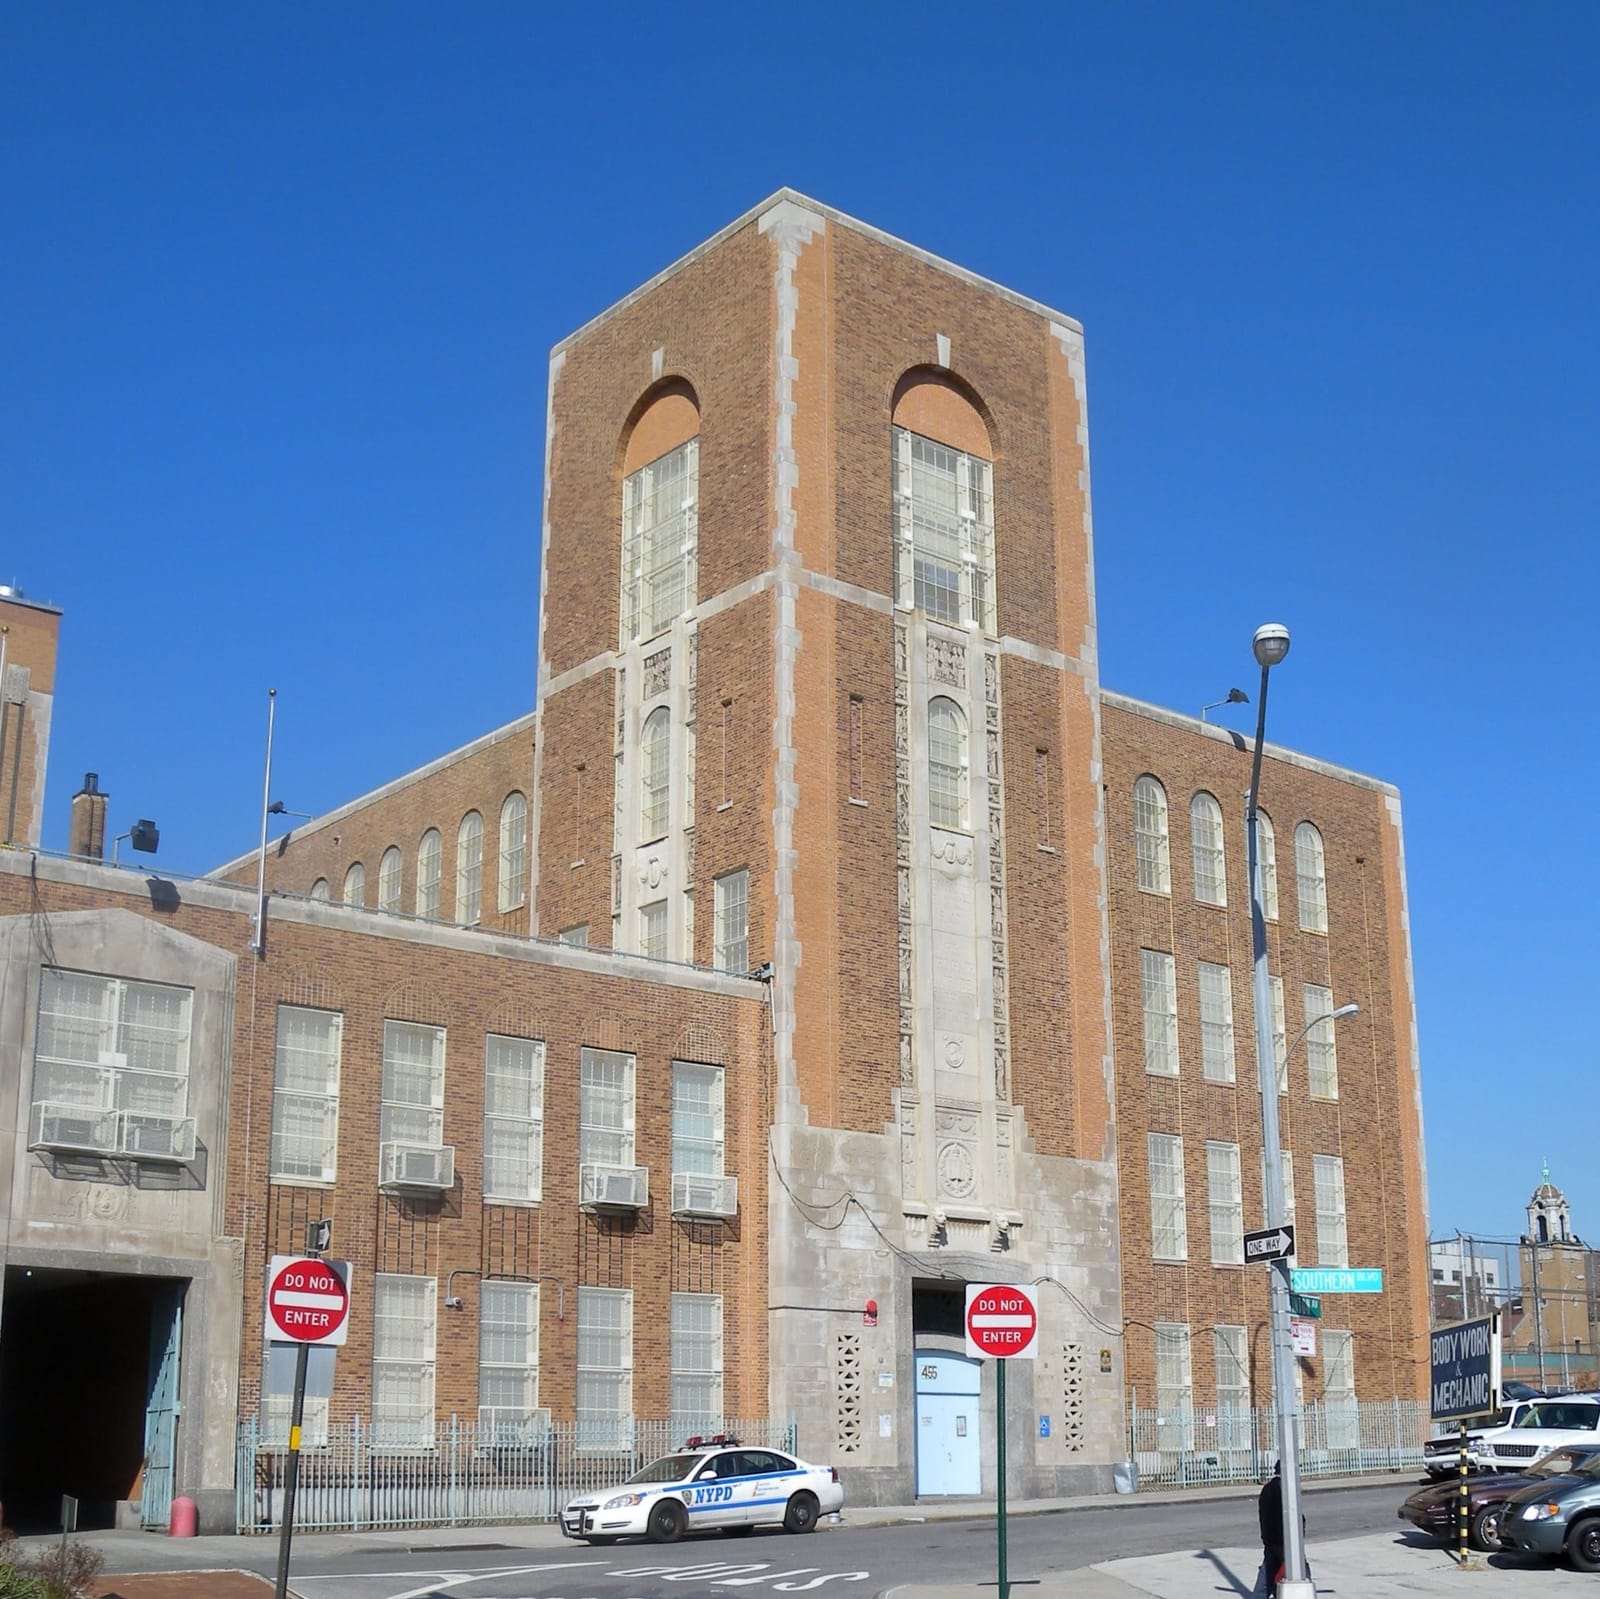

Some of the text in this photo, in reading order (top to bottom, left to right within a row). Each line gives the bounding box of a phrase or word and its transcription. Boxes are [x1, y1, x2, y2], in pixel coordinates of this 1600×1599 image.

[1249, 1237, 1281, 1254] ONE WAY
[285, 1273, 335, 1291] DO NOT
[1294, 1271, 1355, 1290] SOUTHERN
[980, 1300, 1024, 1311] DO NOT
[285, 1310, 329, 1326] ENTER
[982, 1331, 1022, 1343] ENTER
[1432, 1323, 1491, 1366] BODY WORK
[921, 1365, 938, 1380] 455
[1455, 1361, 1462, 1377] &
[1433, 1372, 1489, 1412] MECHANIC
[695, 1486, 733, 1504] NYPD
